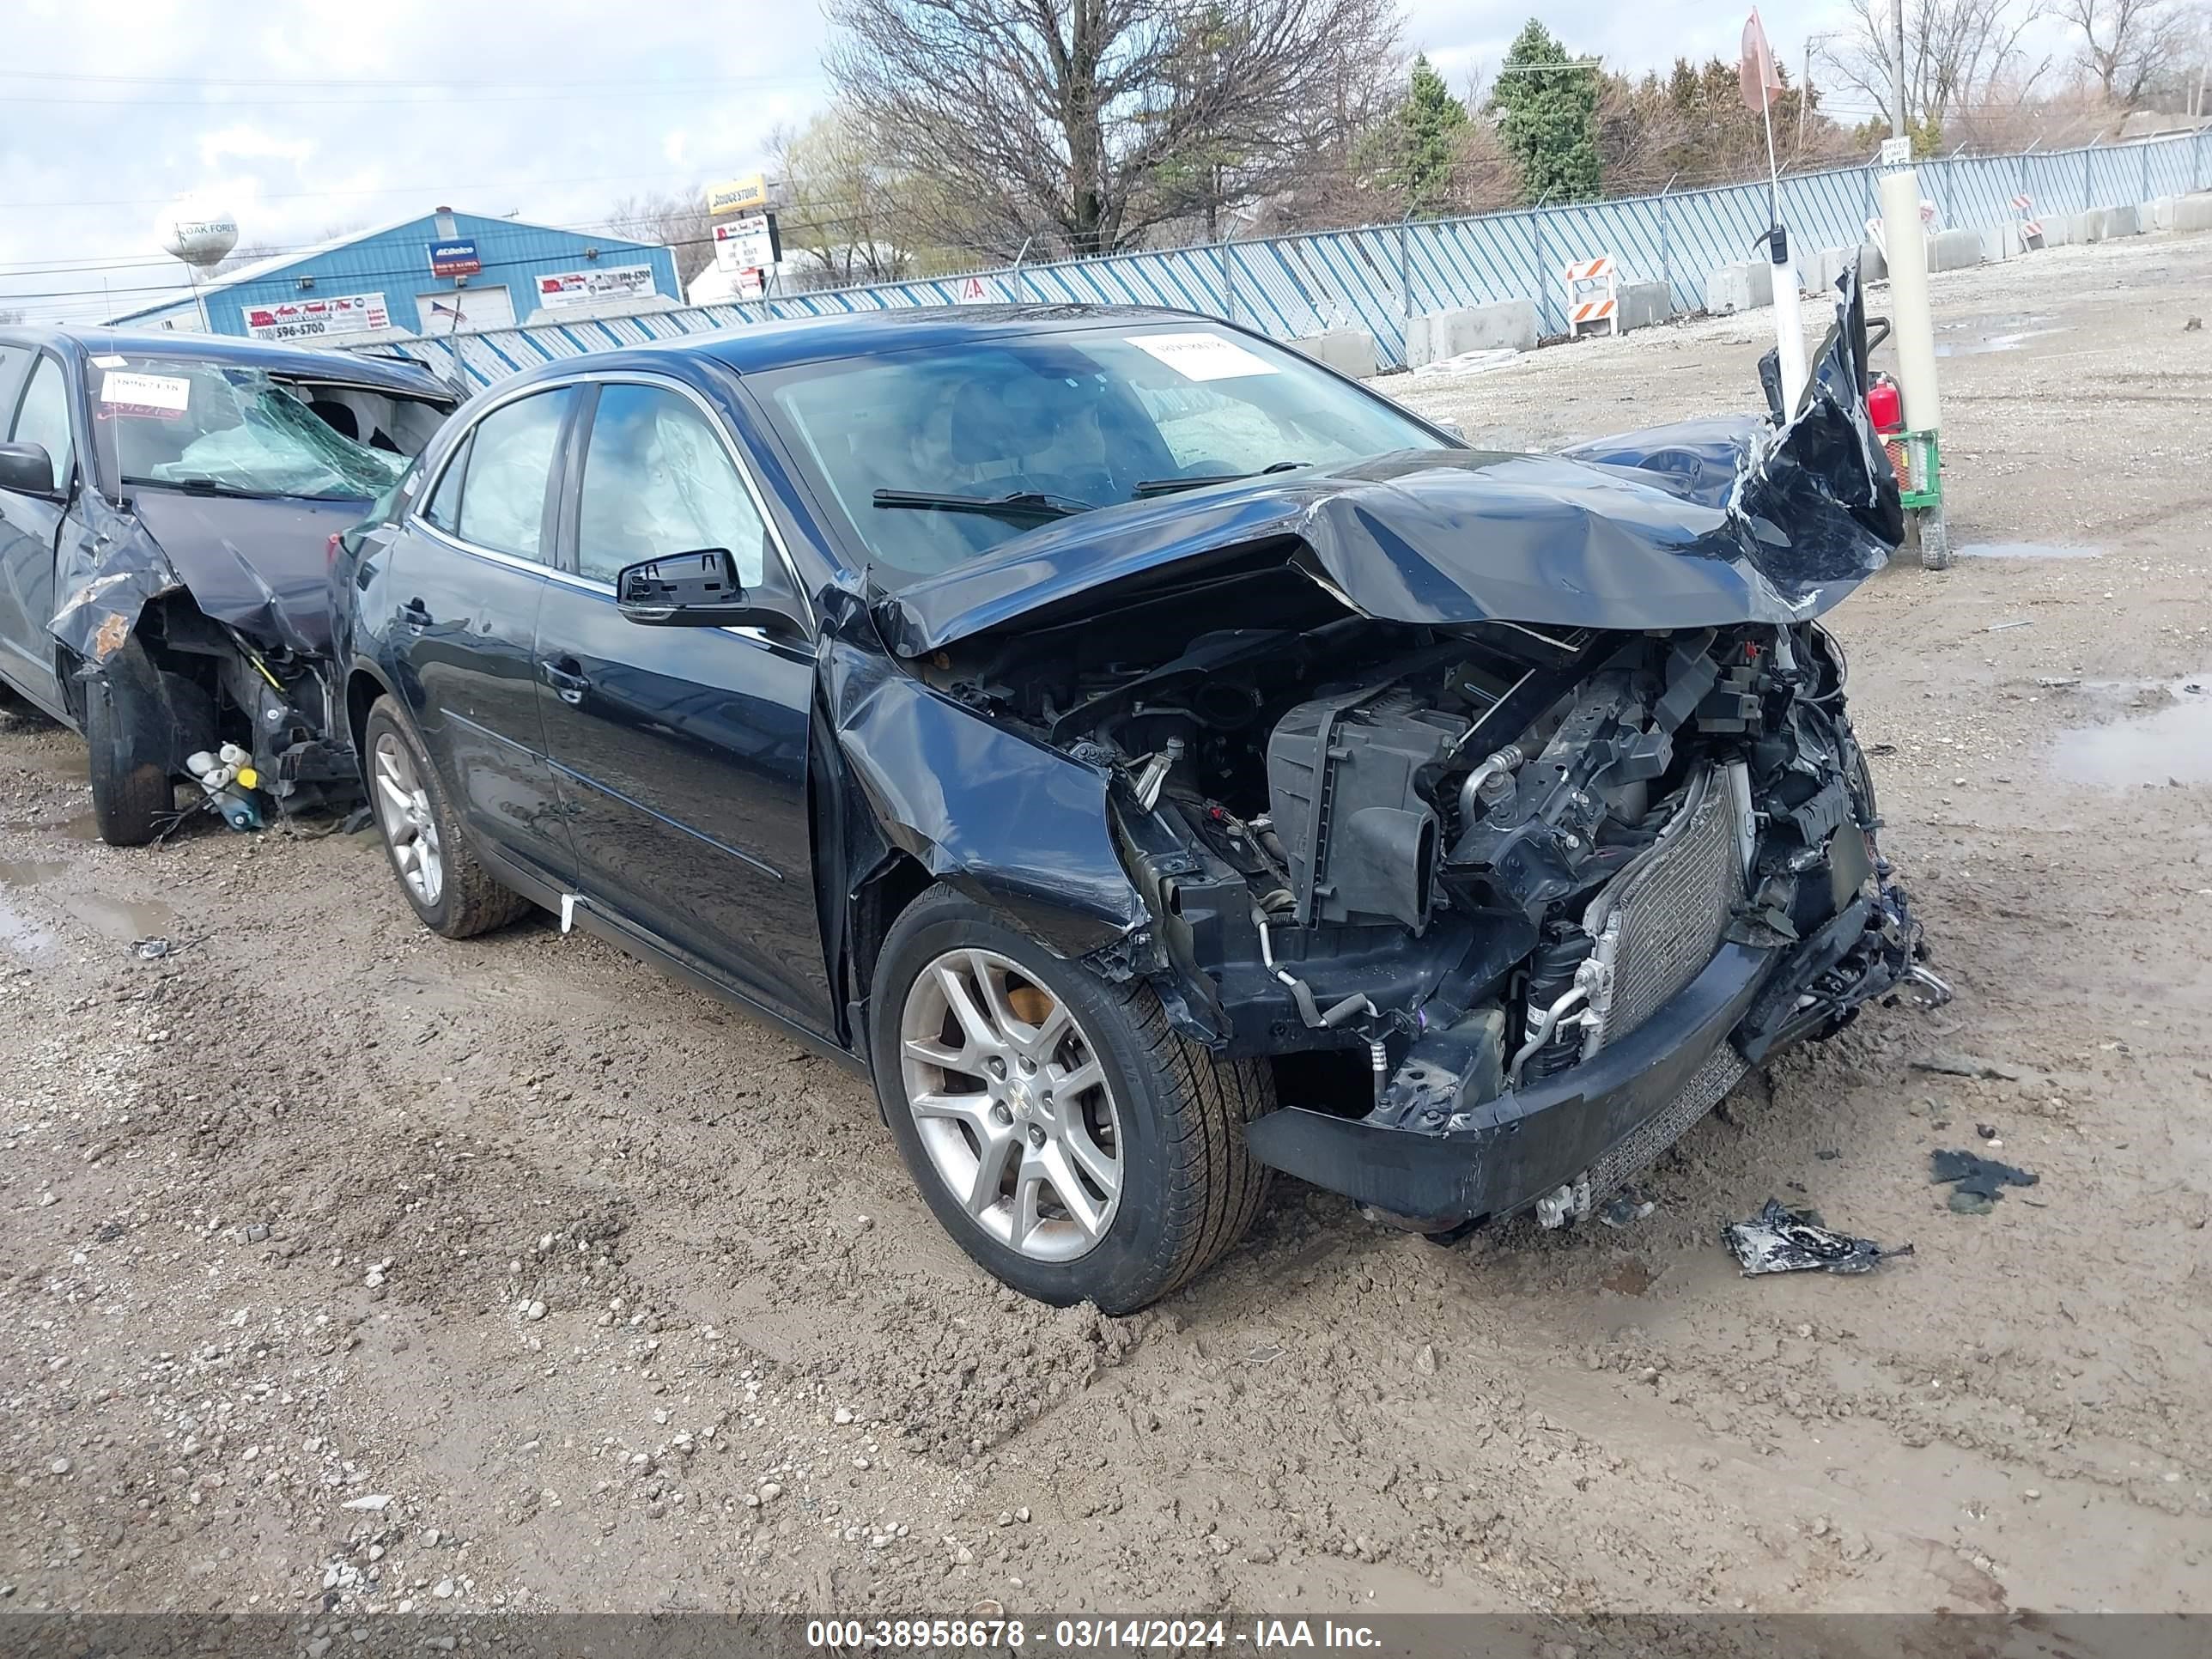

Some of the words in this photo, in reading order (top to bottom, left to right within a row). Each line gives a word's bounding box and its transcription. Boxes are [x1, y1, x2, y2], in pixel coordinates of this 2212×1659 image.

[1884, 142, 1908, 150] SPEED
[1887, 149, 1905, 158] LIMIT
[186, 225, 208, 234] OAK
